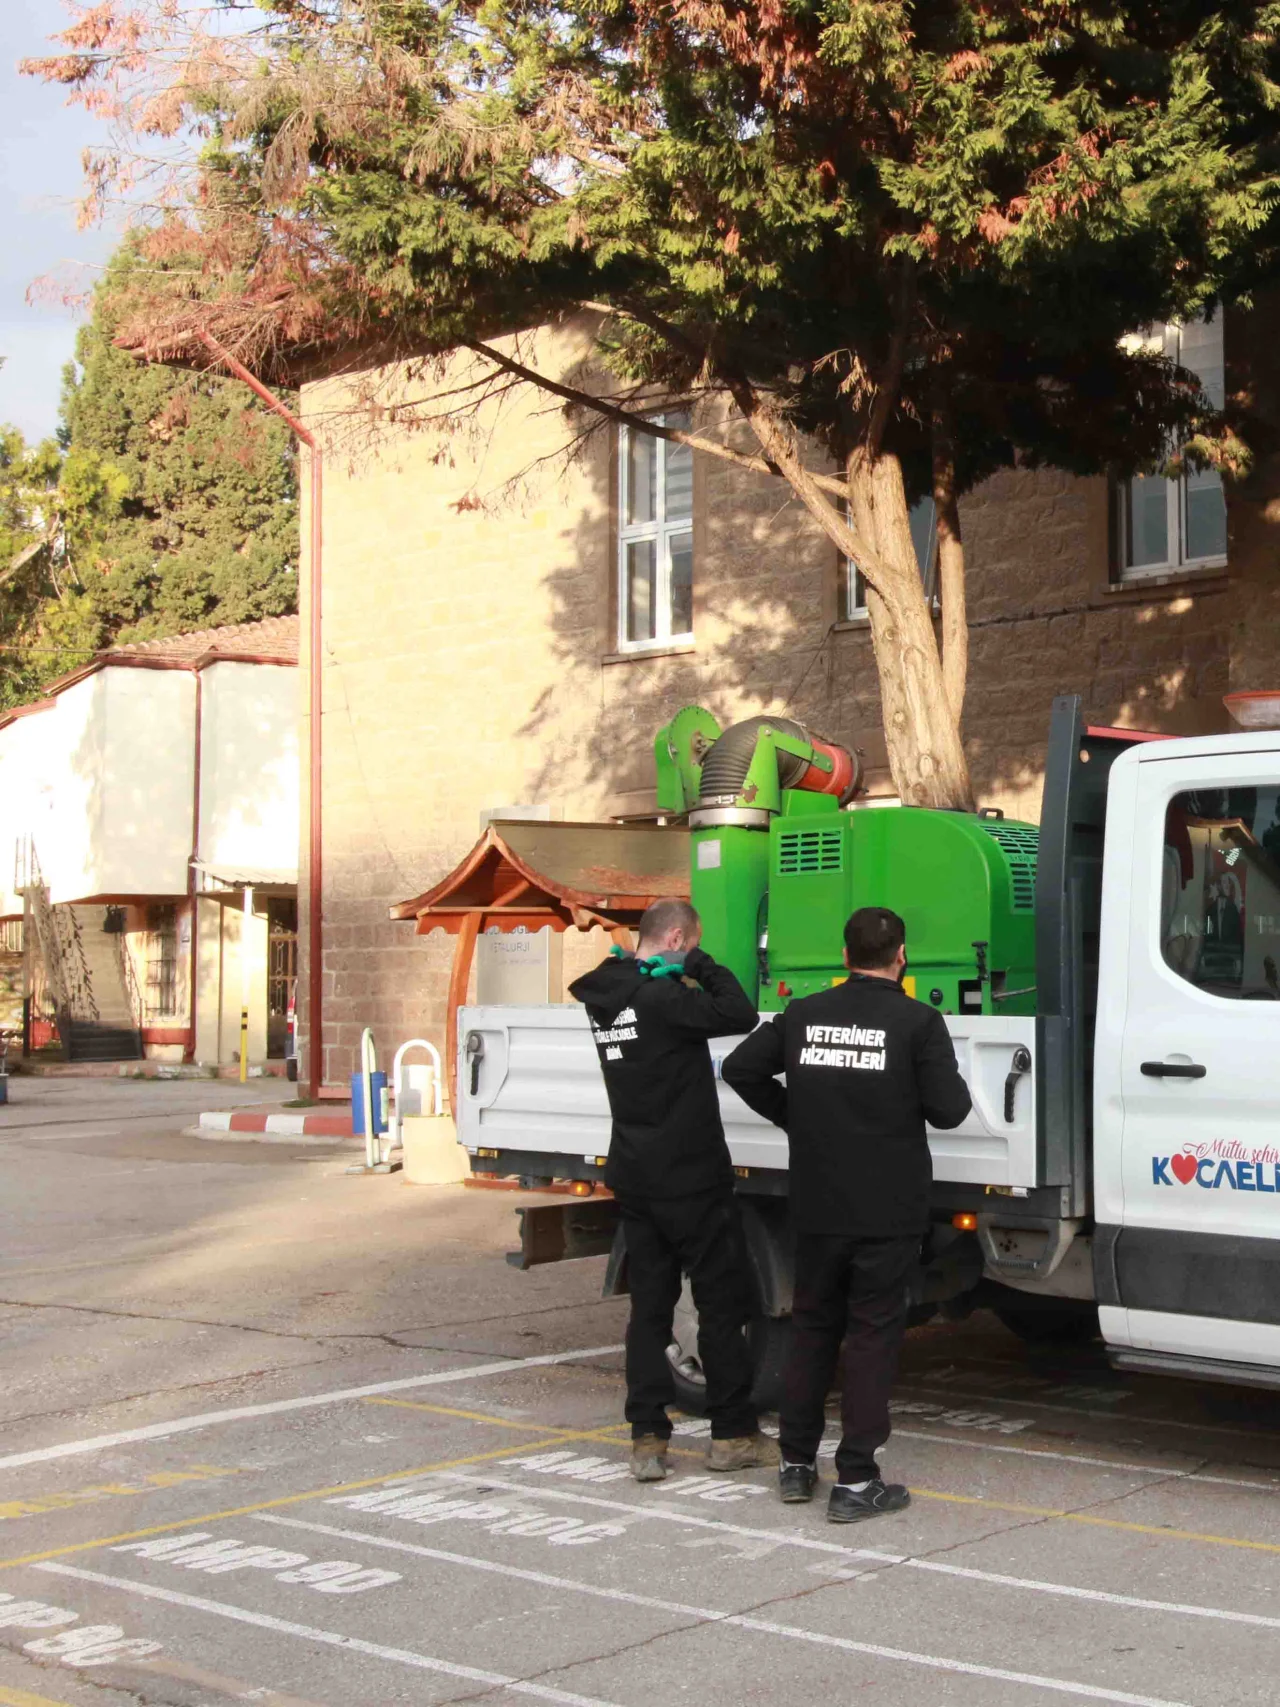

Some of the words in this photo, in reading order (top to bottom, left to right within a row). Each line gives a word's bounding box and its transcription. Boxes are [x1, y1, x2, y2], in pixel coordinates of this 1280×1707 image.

[805, 1024, 886, 1048] VETERİNER
[800, 1045, 886, 1071] HİZMETLERİ
[1183, 1138, 1248, 1161] Mutlu
[1250, 1145, 1280, 1165] şehir
[326, 1487, 510, 1525] AMP
[109, 1532, 309, 1574] AMP
[275, 1561, 403, 1593] 9D
